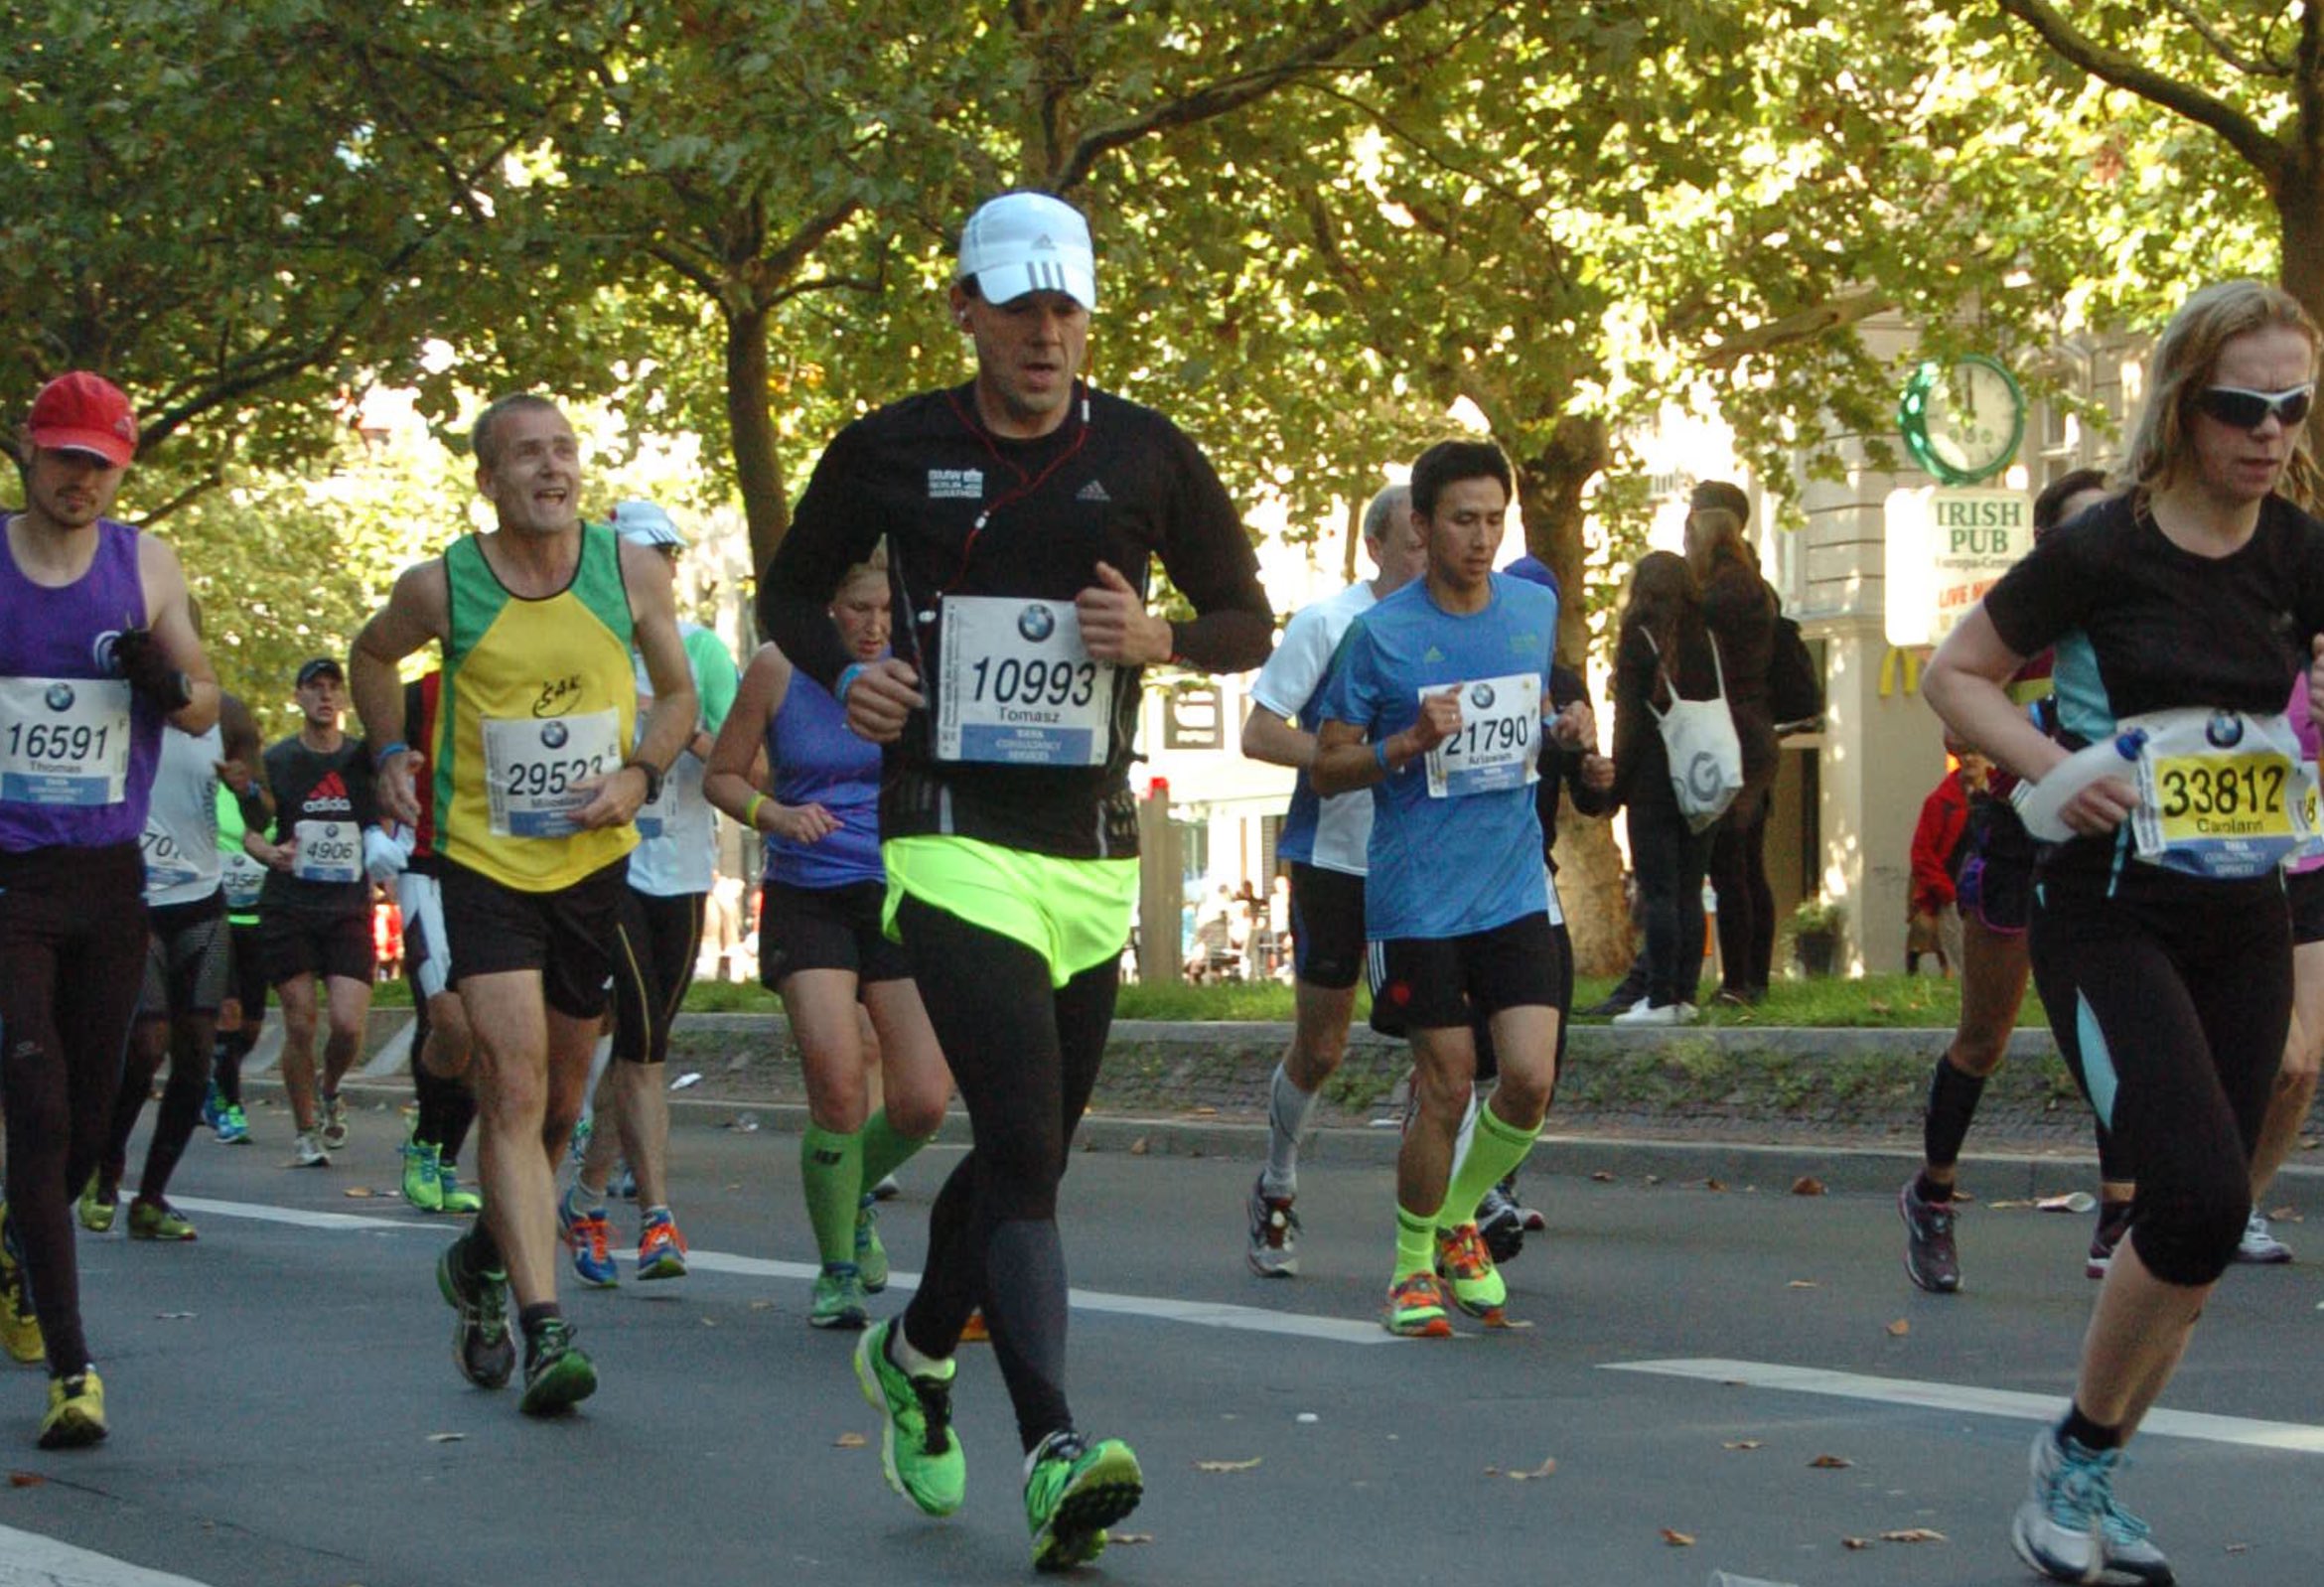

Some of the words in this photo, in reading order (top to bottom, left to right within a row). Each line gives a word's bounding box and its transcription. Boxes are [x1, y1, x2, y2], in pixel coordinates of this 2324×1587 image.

[1937, 502, 2021, 526] IRISH
[1951, 529, 2008, 554] PUB
[1939, 584, 1967, 608] LIVE
[972, 655, 1096, 707] 10993
[998, 707, 1060, 723] Tomasz
[8, 721, 108, 761] 16591
[1445, 715, 1527, 756] 21790
[2162, 765, 2284, 817] 33812
[302, 795, 352, 813] adidas
[307, 841, 354, 860] 4906
